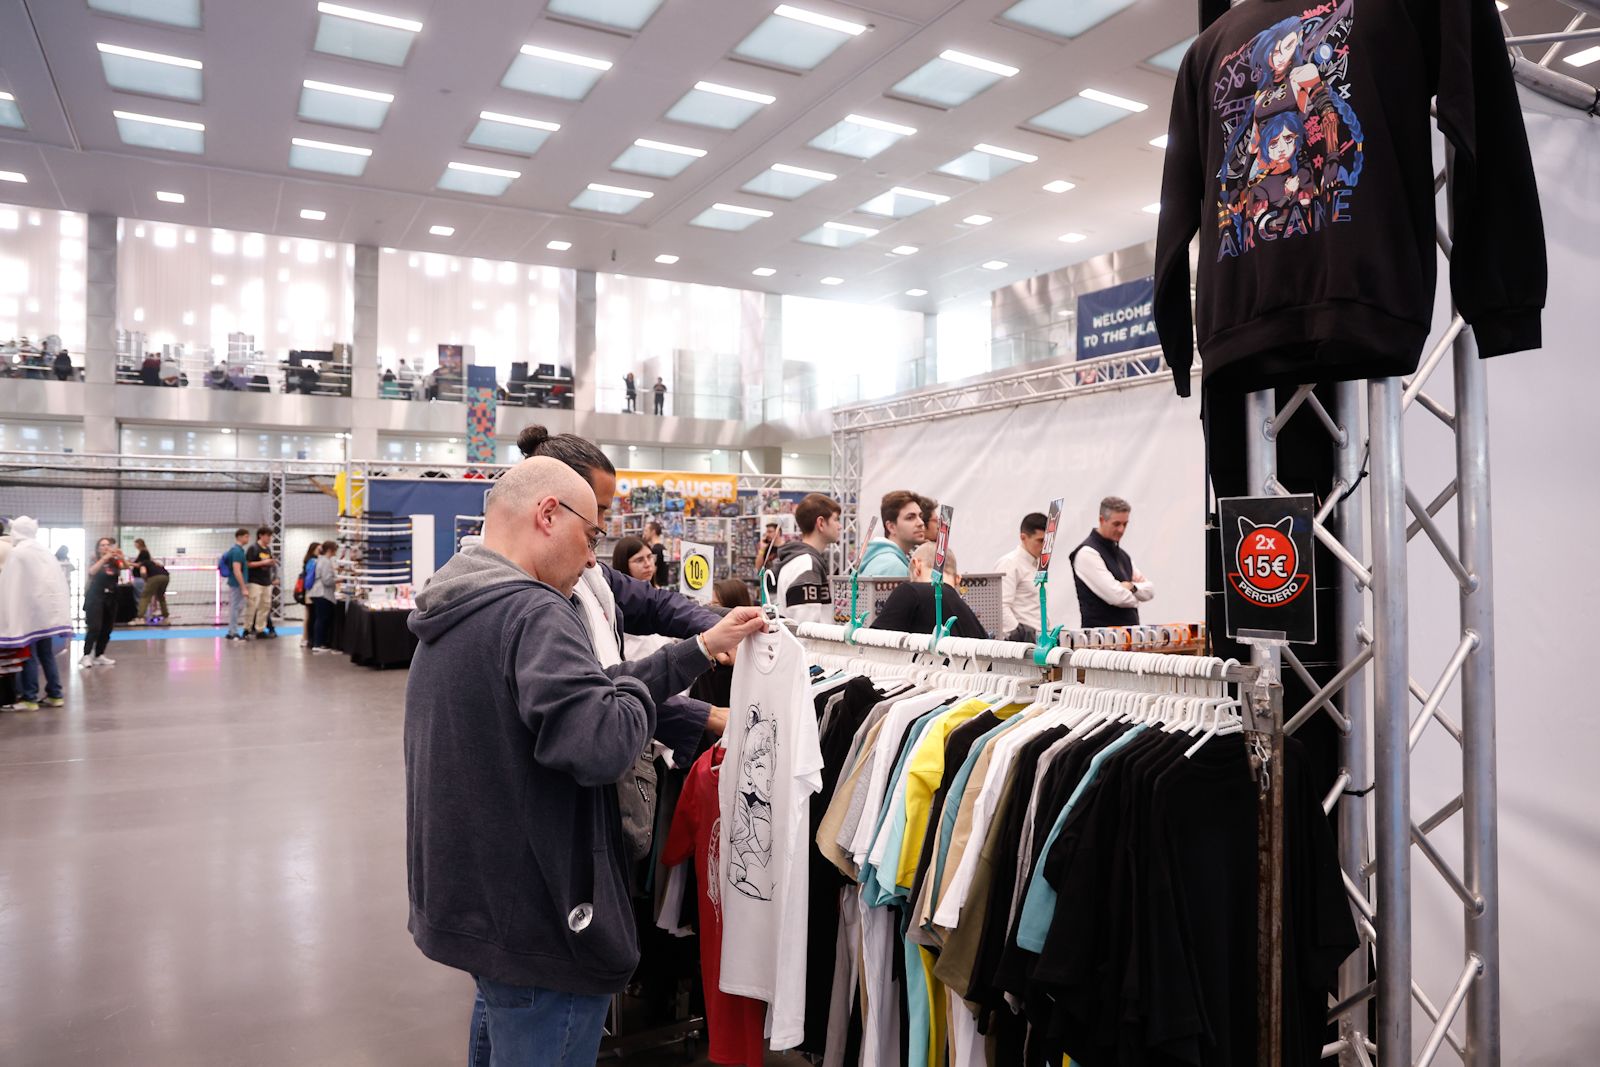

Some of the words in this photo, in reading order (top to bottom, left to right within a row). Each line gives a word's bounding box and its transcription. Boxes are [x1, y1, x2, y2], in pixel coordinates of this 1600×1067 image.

[1217, 189, 1353, 263] ARCANE
[1093, 302, 1152, 329] WELCOME
[1083, 334, 1099, 348] TO
[1102, 329, 1128, 344] THE
[1130, 322, 1157, 337] PLA
[663, 480, 733, 498] SAUCER
[1255, 534, 1276, 550] 2x
[1243, 555, 1288, 578] 15€
[1238, 580, 1299, 604] PERCHERO
